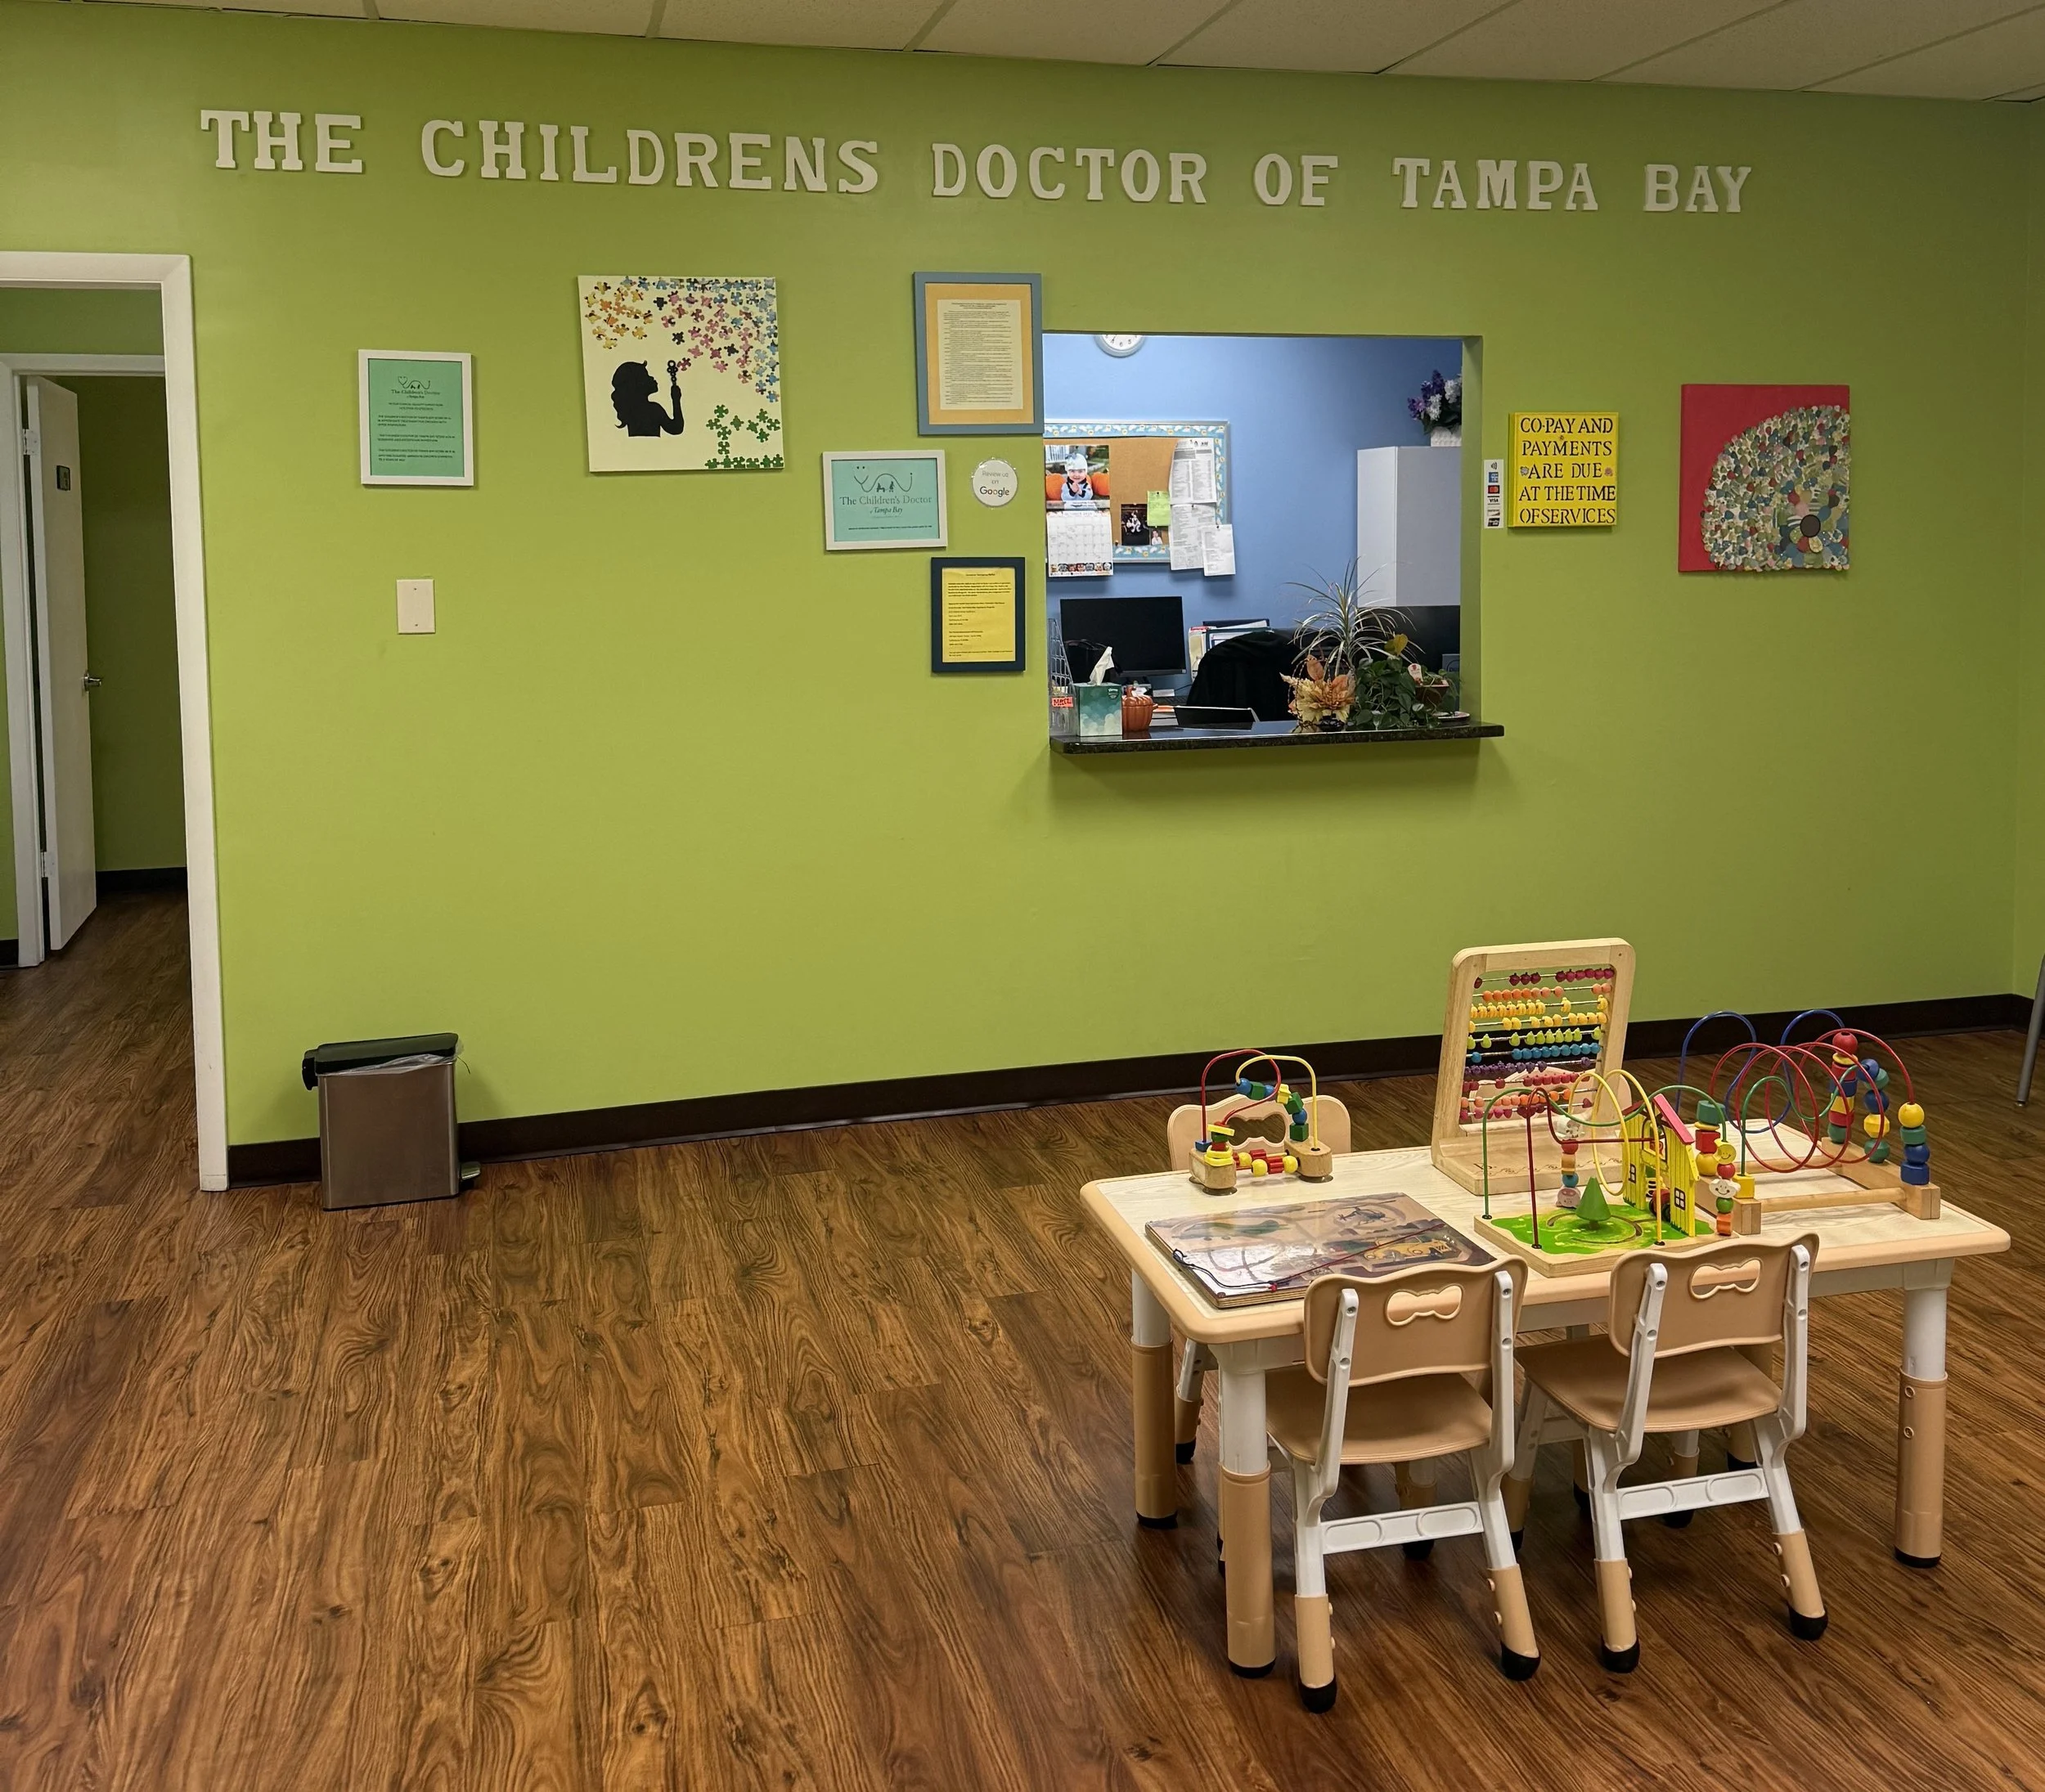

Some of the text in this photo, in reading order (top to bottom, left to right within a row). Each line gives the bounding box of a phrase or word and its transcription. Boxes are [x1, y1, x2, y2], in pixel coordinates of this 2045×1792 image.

[200, 110, 1752, 213] THE CHILDRENS DOCTOR OF TAMPA BAY
[1578, 418, 1614, 433] AND
[1521, 441, 1612, 456] PAYMENTS
[1528, 463, 1602, 478] ARE DUE
[979, 486, 1009, 498] Google
[1518, 486, 1616, 501] AT THE TIME
[839, 495, 933, 505] The Children's Doctor
[893, 506, 903, 514] Bay
